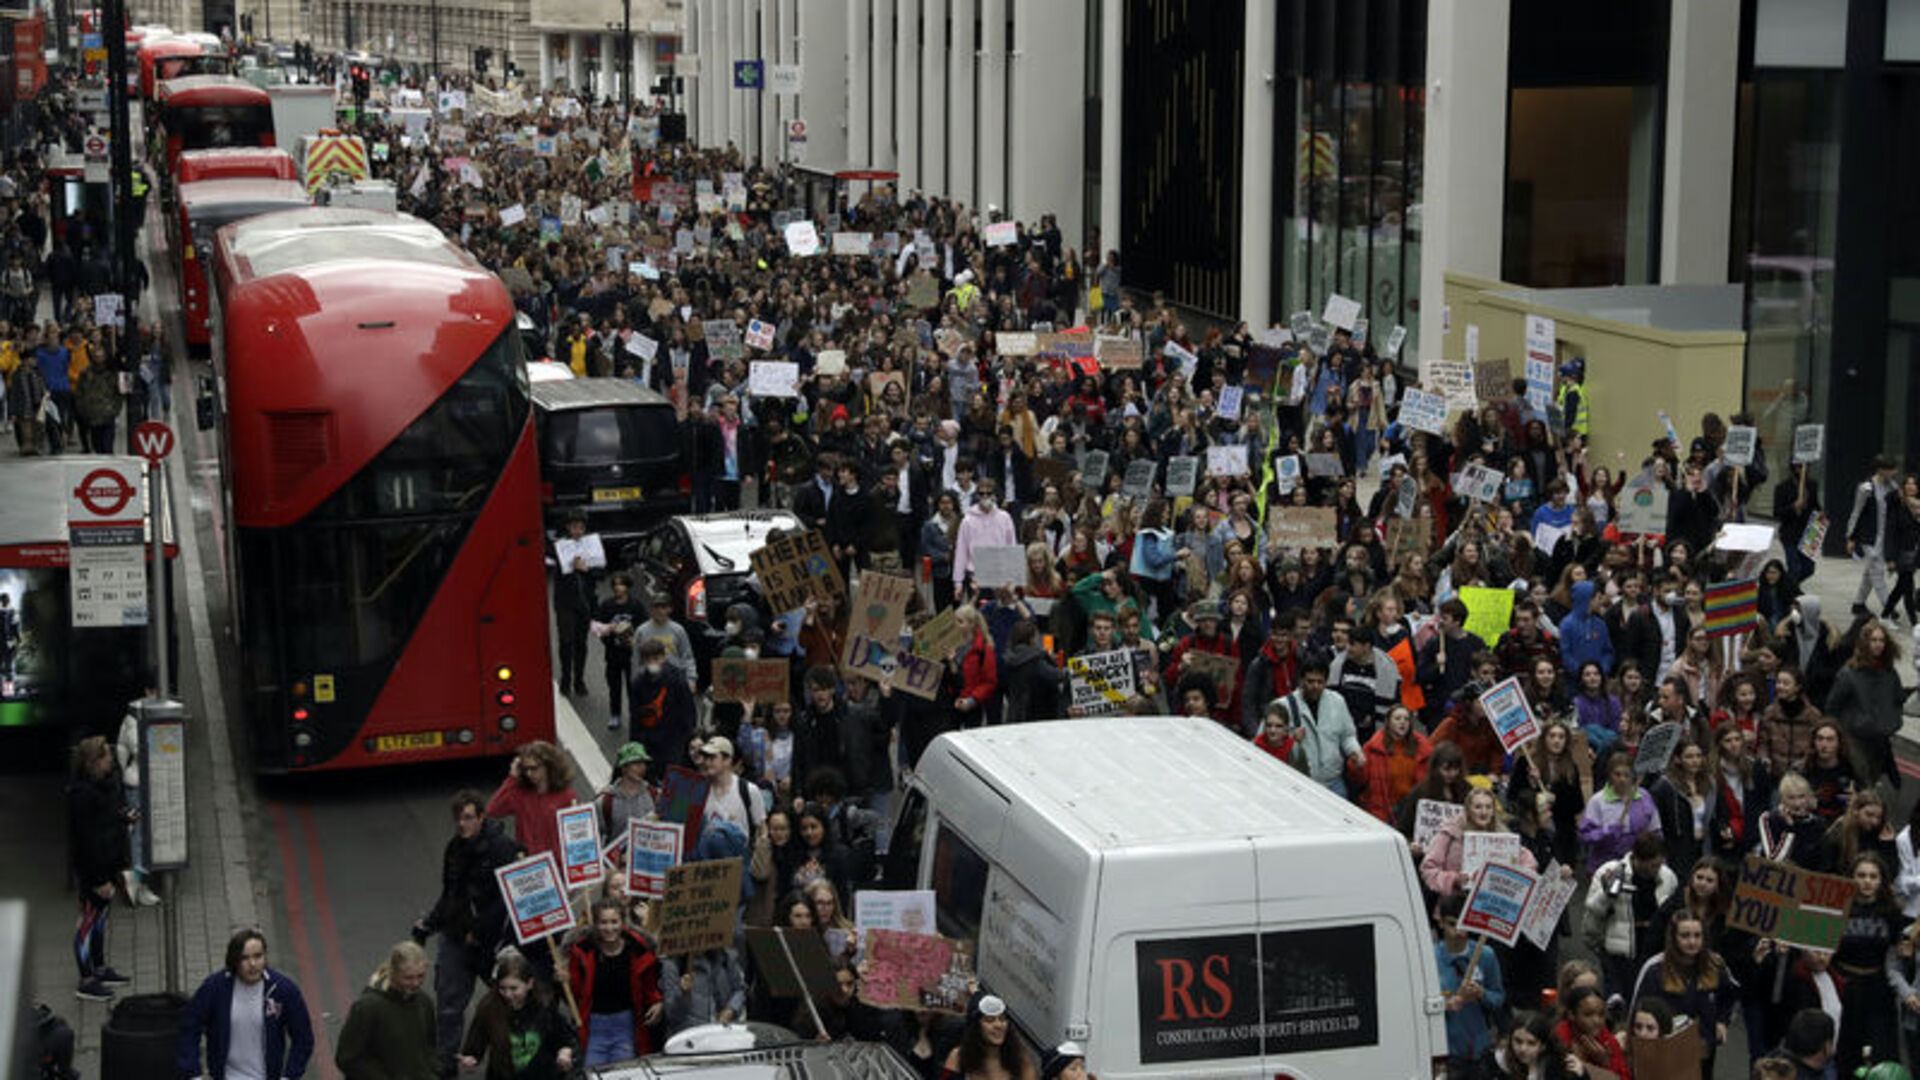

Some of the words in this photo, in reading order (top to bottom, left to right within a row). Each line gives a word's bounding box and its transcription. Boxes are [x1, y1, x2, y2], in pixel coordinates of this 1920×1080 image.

[138, 433, 168, 454] W
[749, 532, 822, 569] THERE
[765, 570, 784, 591] IS
[1087, 662, 1130, 682] ANGRY
[694, 863, 733, 881] PART
[1803, 874, 1857, 910] STOP
[665, 899, 731, 919] SOLUTION
[1734, 895, 1779, 932] YOU
[660, 932, 724, 953] POLLUTION
[1154, 954, 1233, 1021] RS
[1156, 1027, 1227, 1045] CONSTRUCTION
[1230, 1024, 1249, 1040] AND
[1251, 1021, 1297, 1038] PROPERTY
[1299, 1017, 1340, 1035] SERVICES
[1341, 1014, 1360, 1031] LTD
